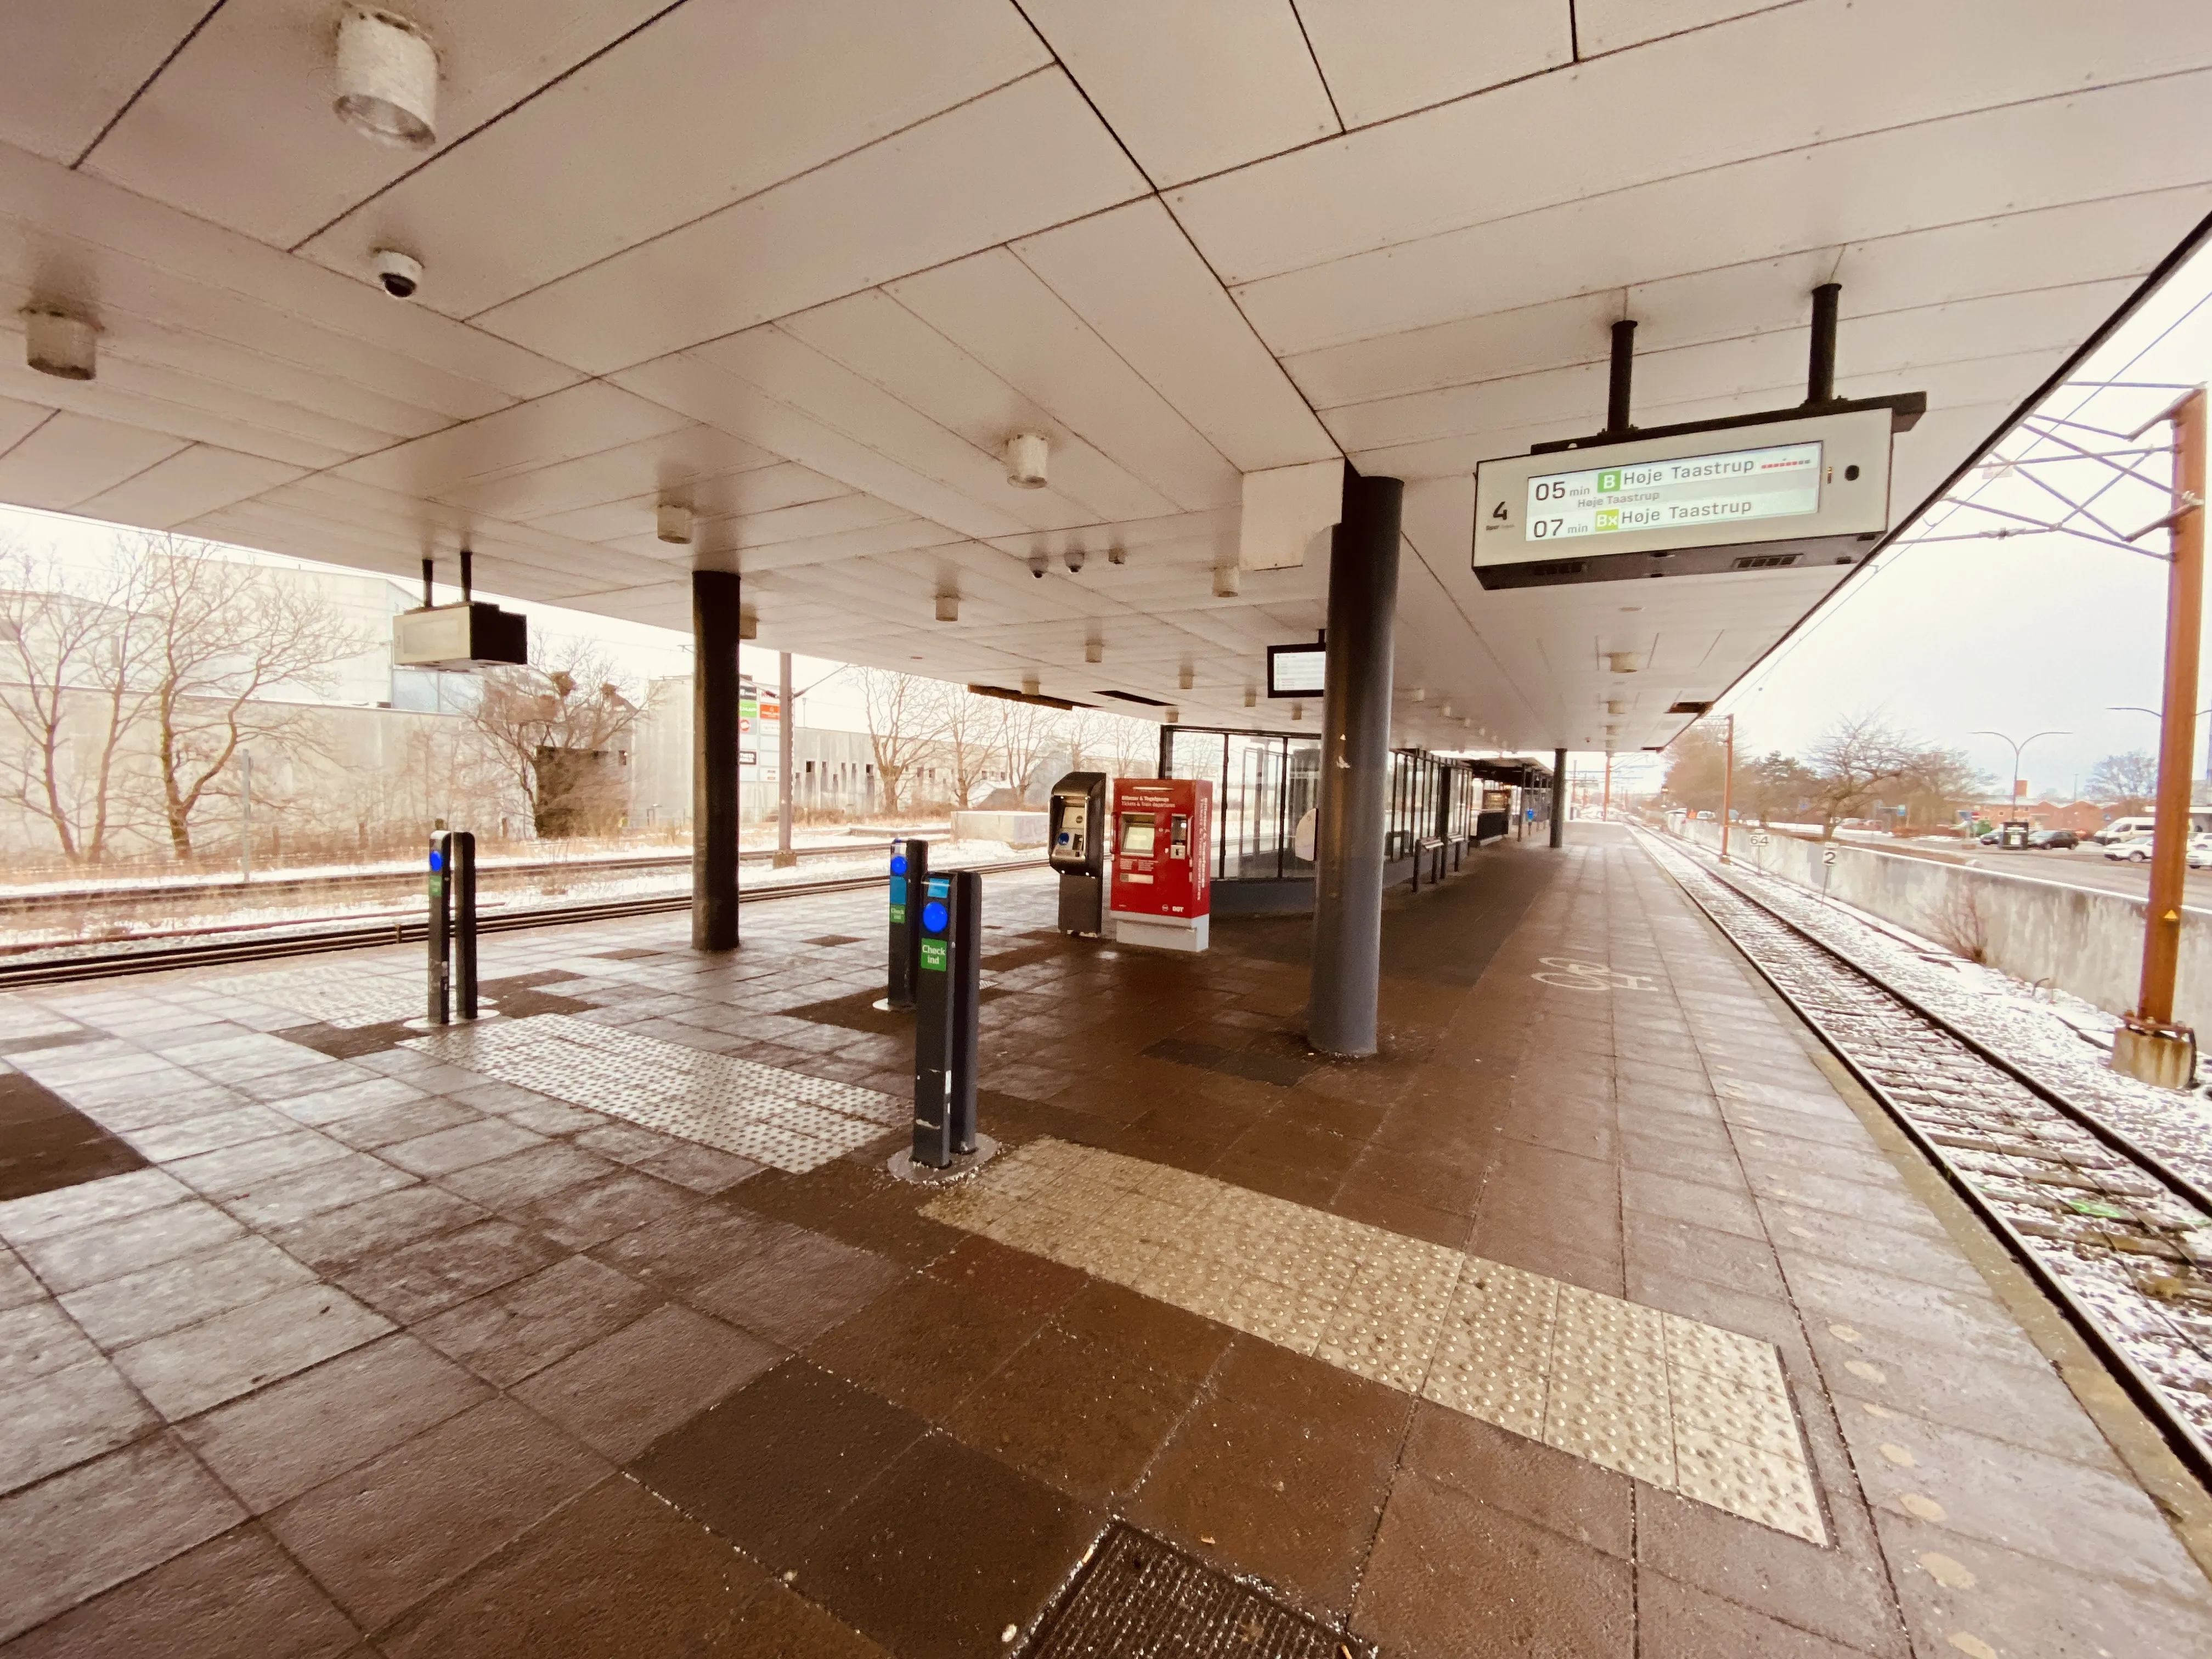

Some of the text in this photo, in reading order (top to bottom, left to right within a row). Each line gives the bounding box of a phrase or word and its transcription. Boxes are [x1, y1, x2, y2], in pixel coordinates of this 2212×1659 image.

[1536, 460, 1754, 500] 05 min B Høje Taastrup
[1578, 492, 1660, 509] Høje Taastrup
[1493, 501, 1507, 520] 4
[1534, 501, 1752, 538] 07 min Bx Høje Taastrup
[1751, 836, 1769, 844] 64
[1824, 852, 1836, 864] 2
[922, 945, 946, 955] Check
[928, 956, 939, 964] ind
